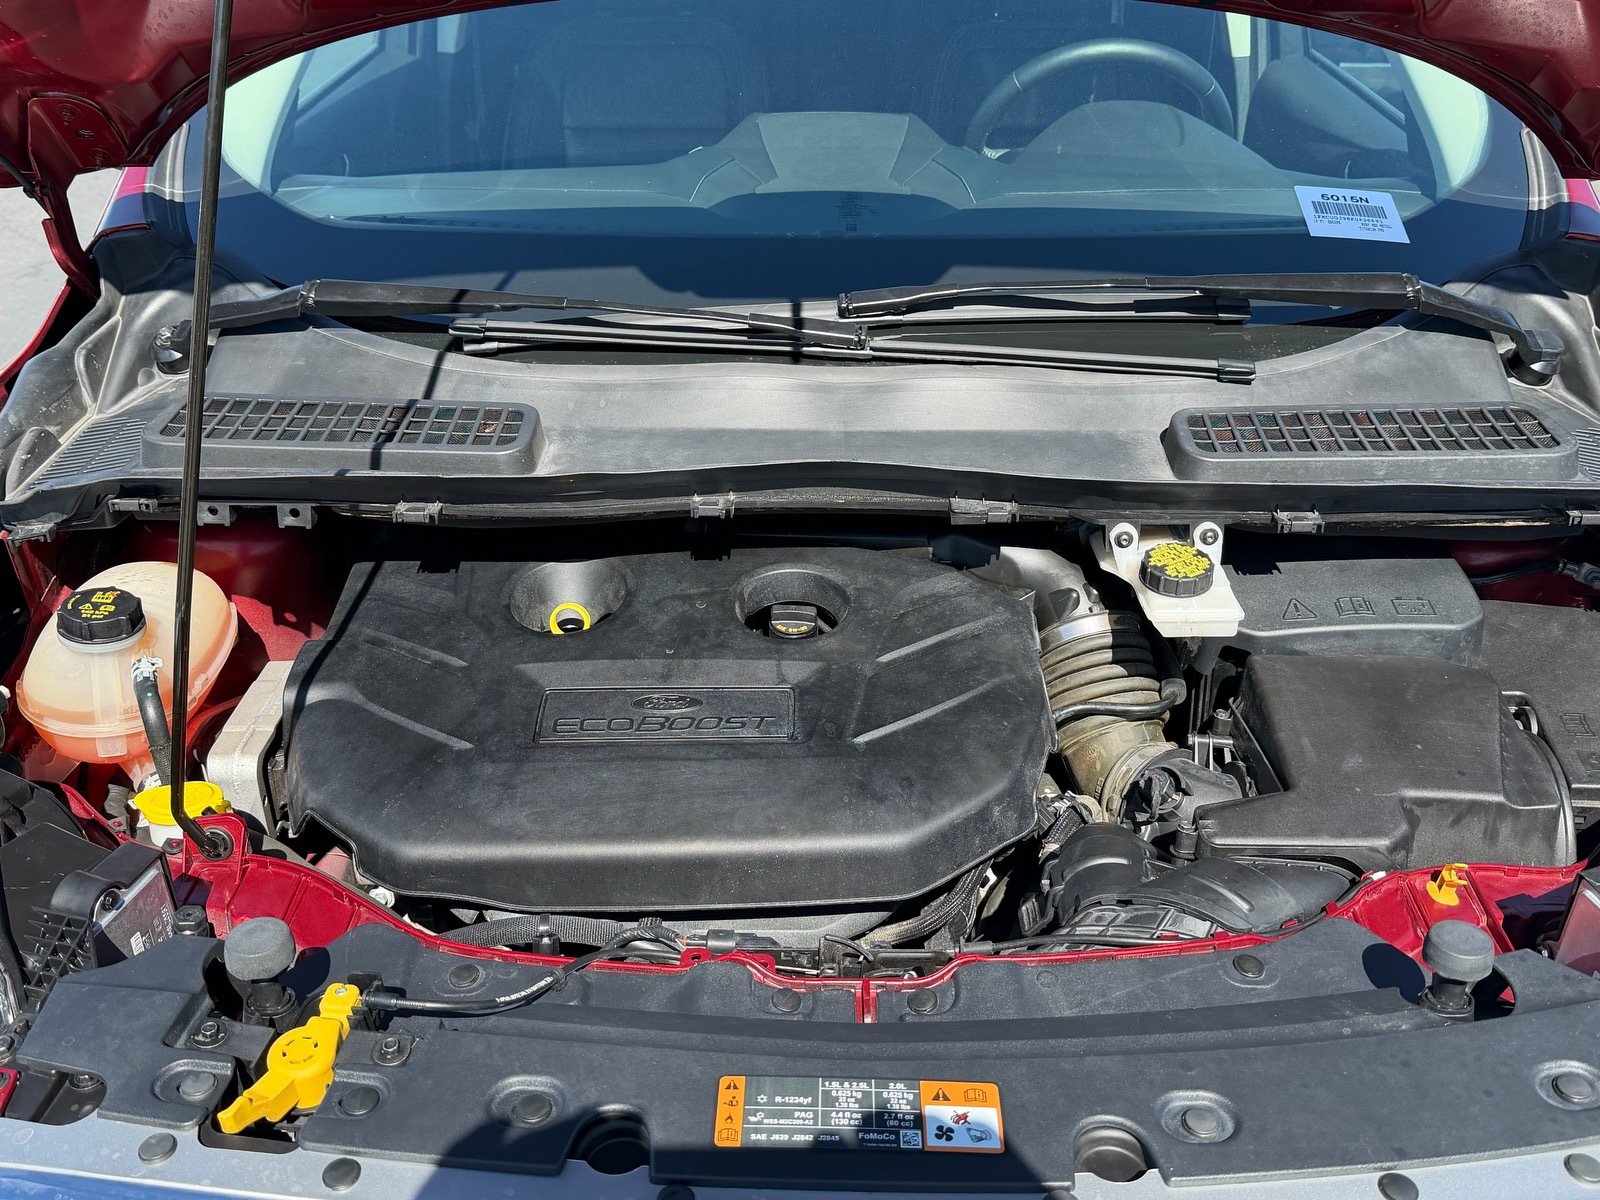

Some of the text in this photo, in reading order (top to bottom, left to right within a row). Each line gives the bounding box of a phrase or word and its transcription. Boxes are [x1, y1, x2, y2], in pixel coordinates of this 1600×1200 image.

[1321, 194, 1370, 204] 5015N
[852, 1090, 862, 1098] kg
[904, 1092, 914, 1100] kg
[775, 1096, 813, 1105] R-1234yf
[901, 1120, 913, 1128] cc)
[858, 1132, 896, 1140] FoMoCo
